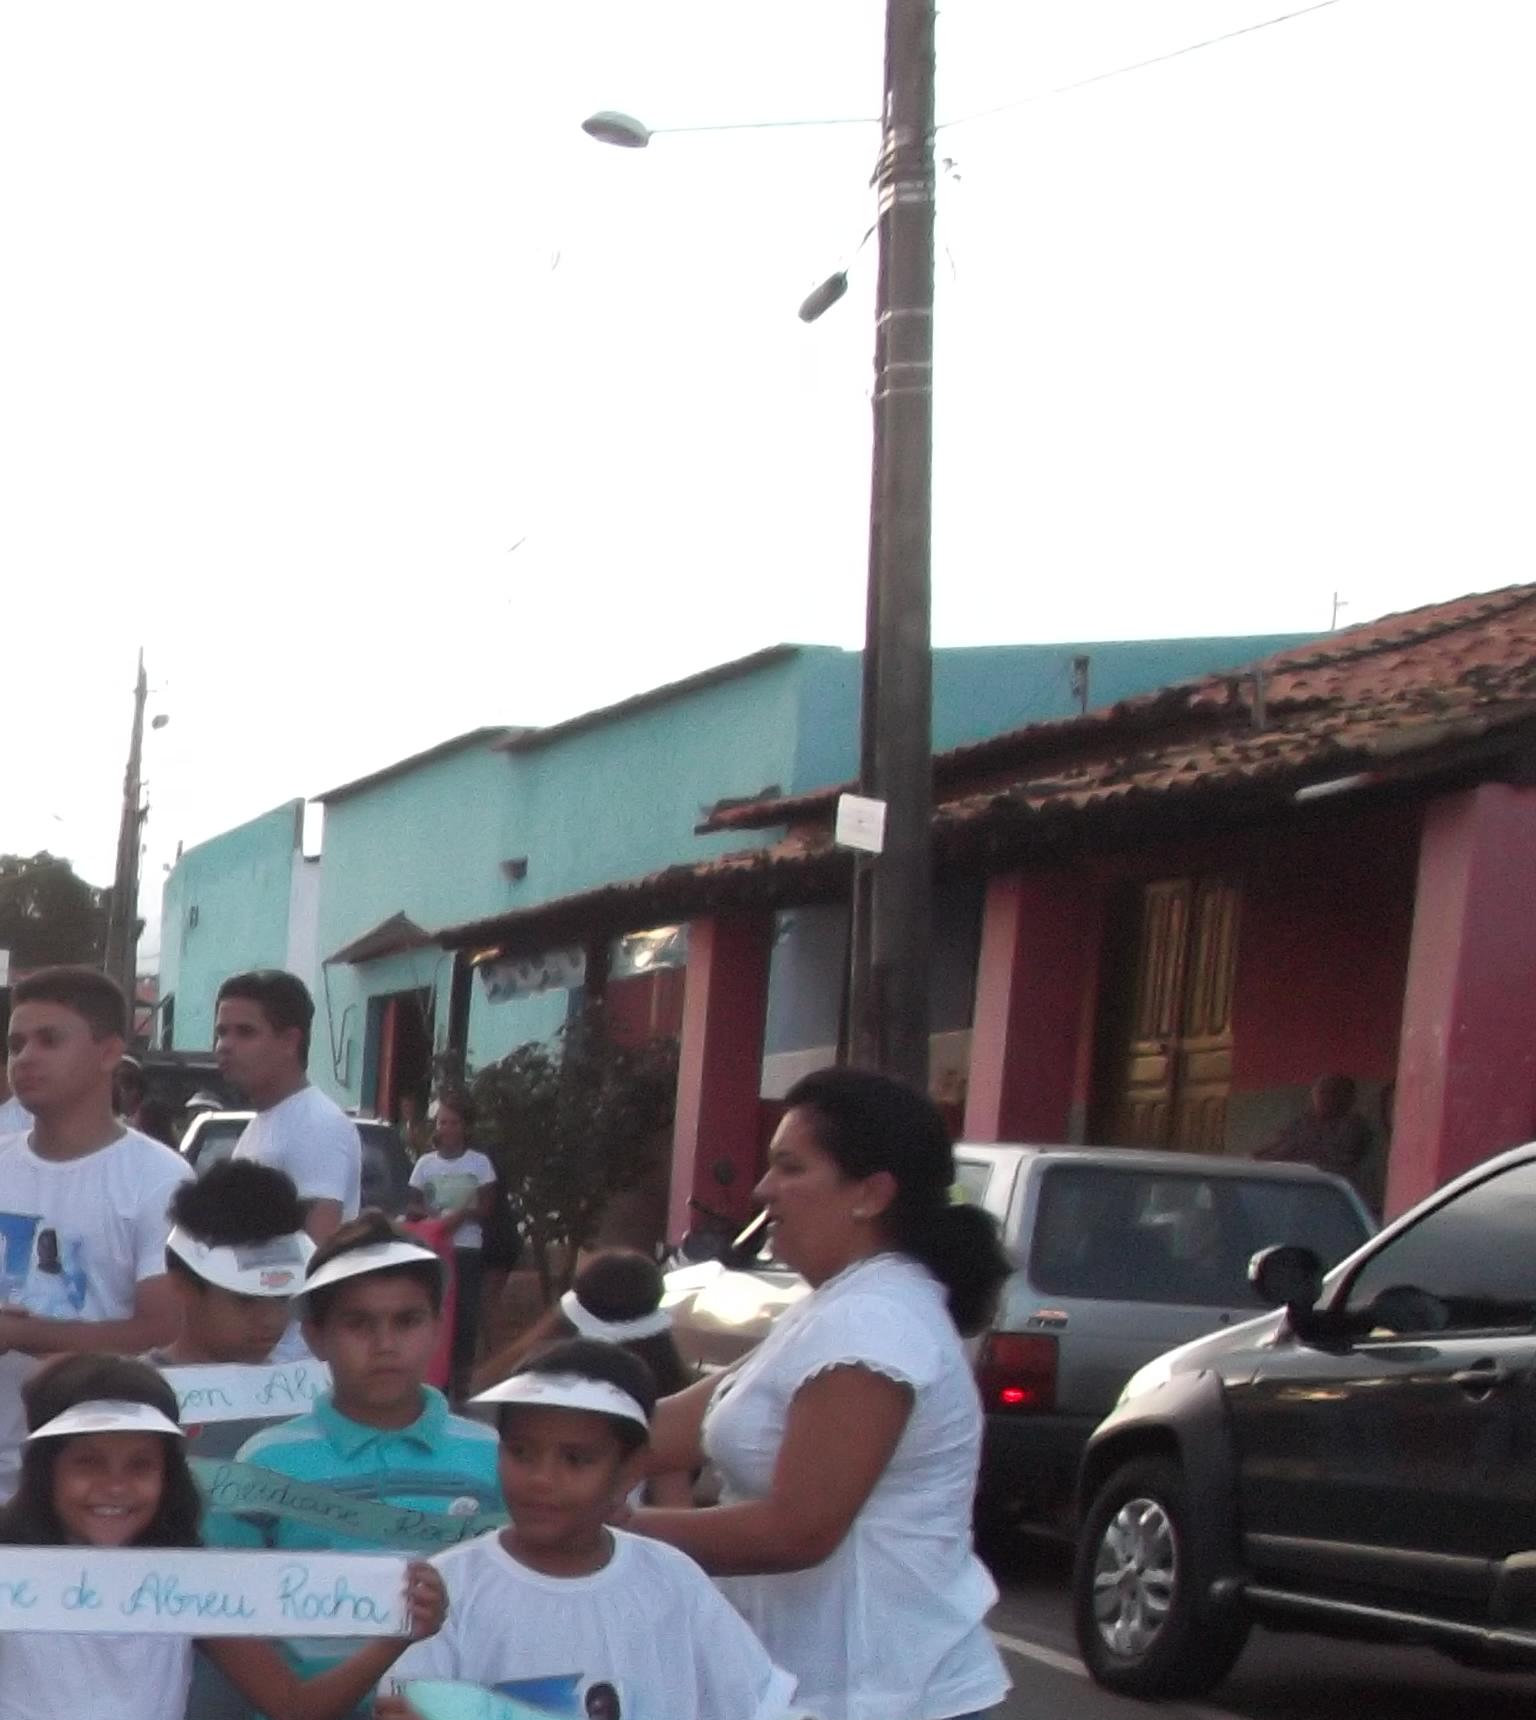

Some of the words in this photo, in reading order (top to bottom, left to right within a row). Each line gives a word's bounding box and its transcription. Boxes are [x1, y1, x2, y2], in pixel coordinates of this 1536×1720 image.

[60, 1570, 103, 1613] de
[119, 1570, 259, 1619] Abreu
[278, 1565, 392, 1626] Rocha
